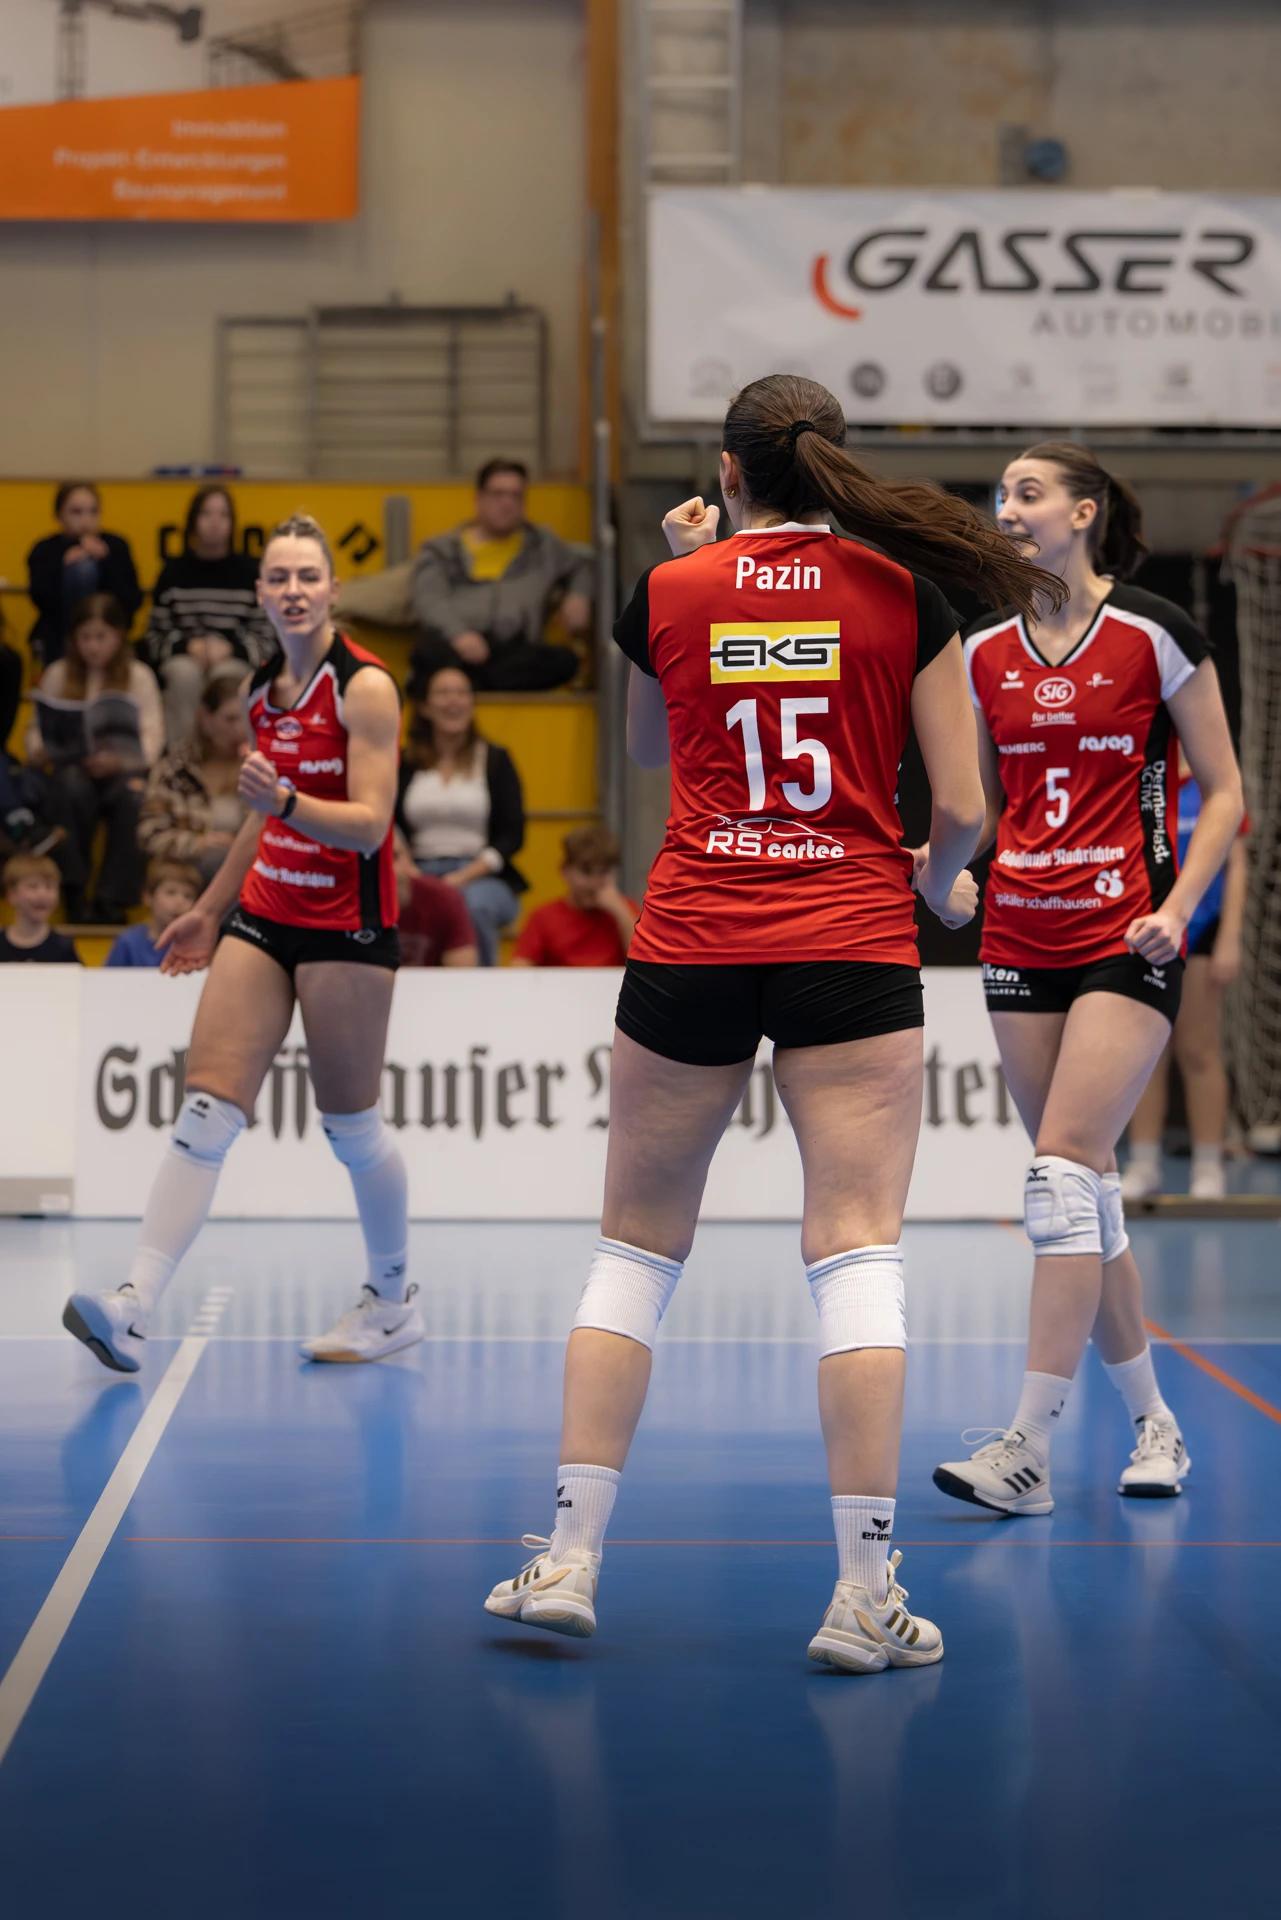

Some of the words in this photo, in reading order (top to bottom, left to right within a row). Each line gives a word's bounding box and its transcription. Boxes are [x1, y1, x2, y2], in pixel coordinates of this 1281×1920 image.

[846, 229, 1256, 296] GASSER
[735, 556, 821, 590] Pazin
[711, 637, 840, 667] EKS
[1041, 684, 1068, 701] SIG
[1032, 711, 1046, 722] for
[1047, 710, 1076, 721] better
[725, 697, 833, 812] 15
[1045, 767, 1070, 829] 5
[706, 831, 762, 857] RS
[767, 839, 845, 859] cartec
[861, 1530, 892, 1541] erim
